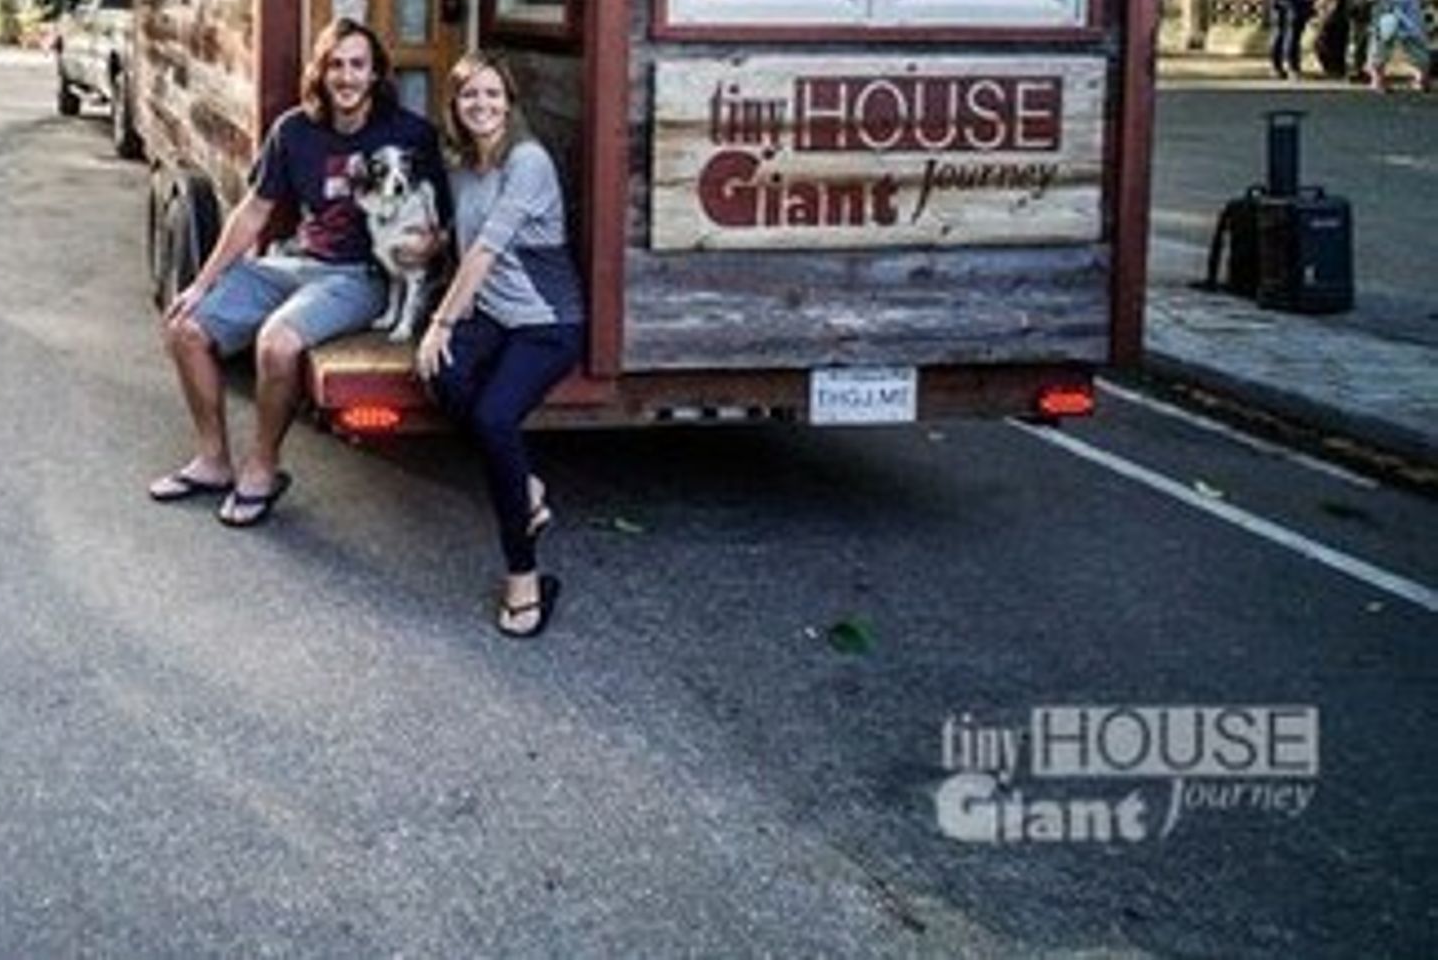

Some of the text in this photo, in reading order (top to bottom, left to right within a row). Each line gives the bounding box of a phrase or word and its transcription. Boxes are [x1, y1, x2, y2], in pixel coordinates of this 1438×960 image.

[709, 78, 1055, 158] tiny HOUSE
[698, 150, 900, 228] Giant
